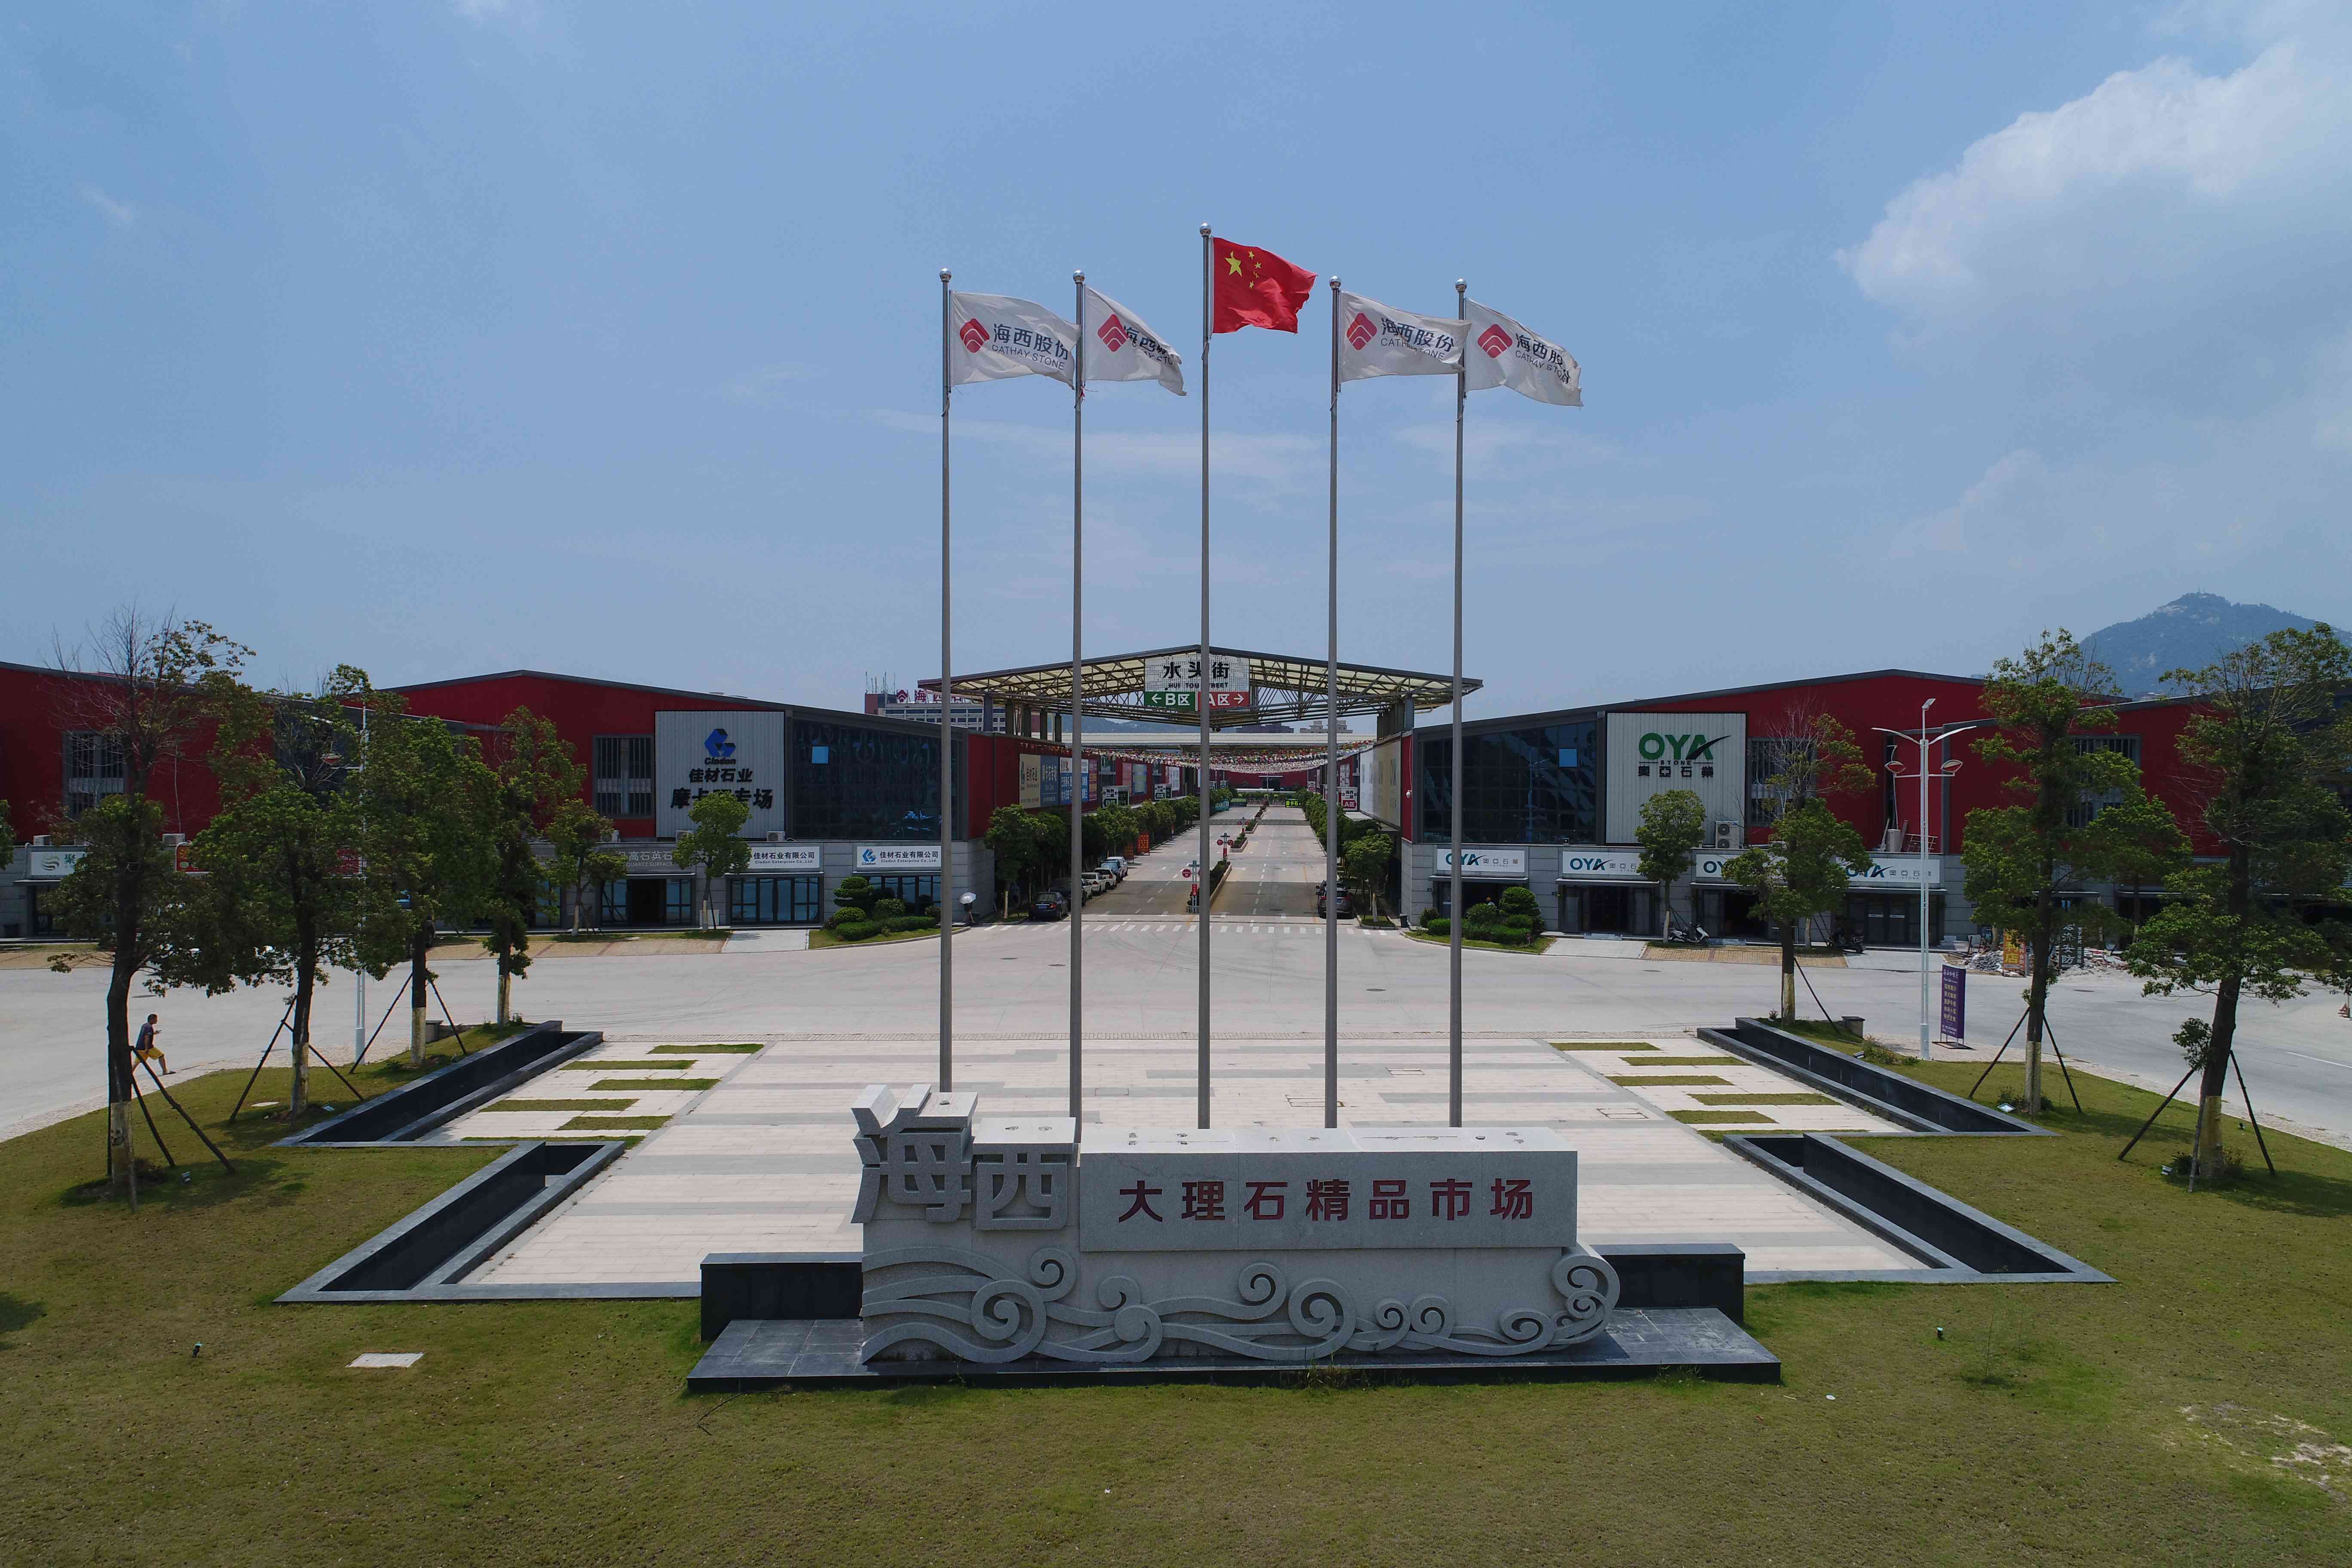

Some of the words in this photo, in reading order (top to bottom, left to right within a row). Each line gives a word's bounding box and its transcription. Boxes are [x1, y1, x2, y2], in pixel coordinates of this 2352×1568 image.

[994, 323, 1068, 360] 海西股份
[1381, 318, 1454, 352] 海西股份
[992, 345, 1030, 357] CATHAY
[1032, 353, 1065, 370] STONE
[1516, 350, 1544, 368] CATHAY
[1163, 662, 1230, 679] 水头街
[1166, 693, 1190, 706] B区
[1209, 694, 1230, 706] A区
[1638, 733, 1719, 760] OYA
[689, 768, 753, 782] 佳材石业
[671, 787, 773, 808] 摩卡专场
[1570, 858, 1605, 870] OYA
[851, 1108, 1073, 1230] 海西
[1118, 1179, 1533, 1223] 大理石精品市场
